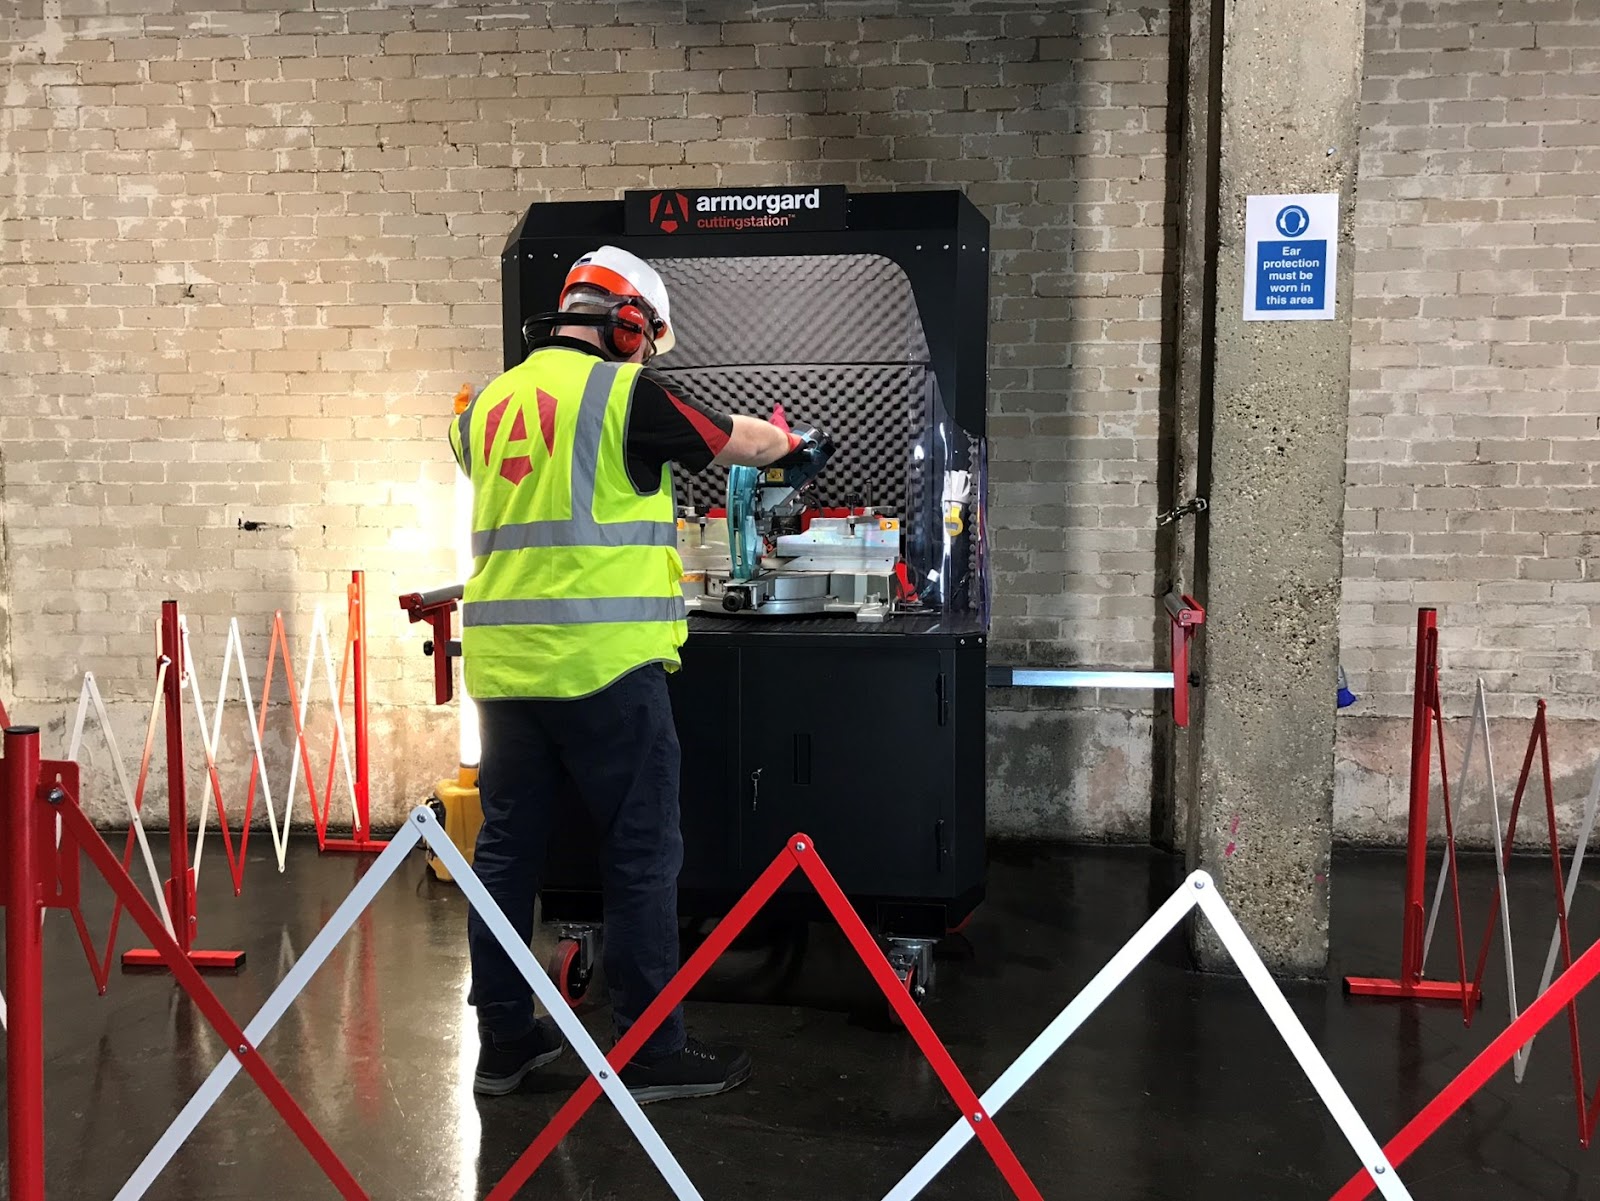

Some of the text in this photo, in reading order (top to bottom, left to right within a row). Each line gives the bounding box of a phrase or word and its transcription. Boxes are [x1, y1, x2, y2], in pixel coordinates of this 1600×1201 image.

[696, 188, 820, 213] armorgard
[1282, 246, 1301, 256] Ear
[1263, 258, 1319, 270] protection
[1269, 271, 1313, 280] must be
[1270, 283, 1311, 293] worn in
[1266, 296, 1314, 305] this area
